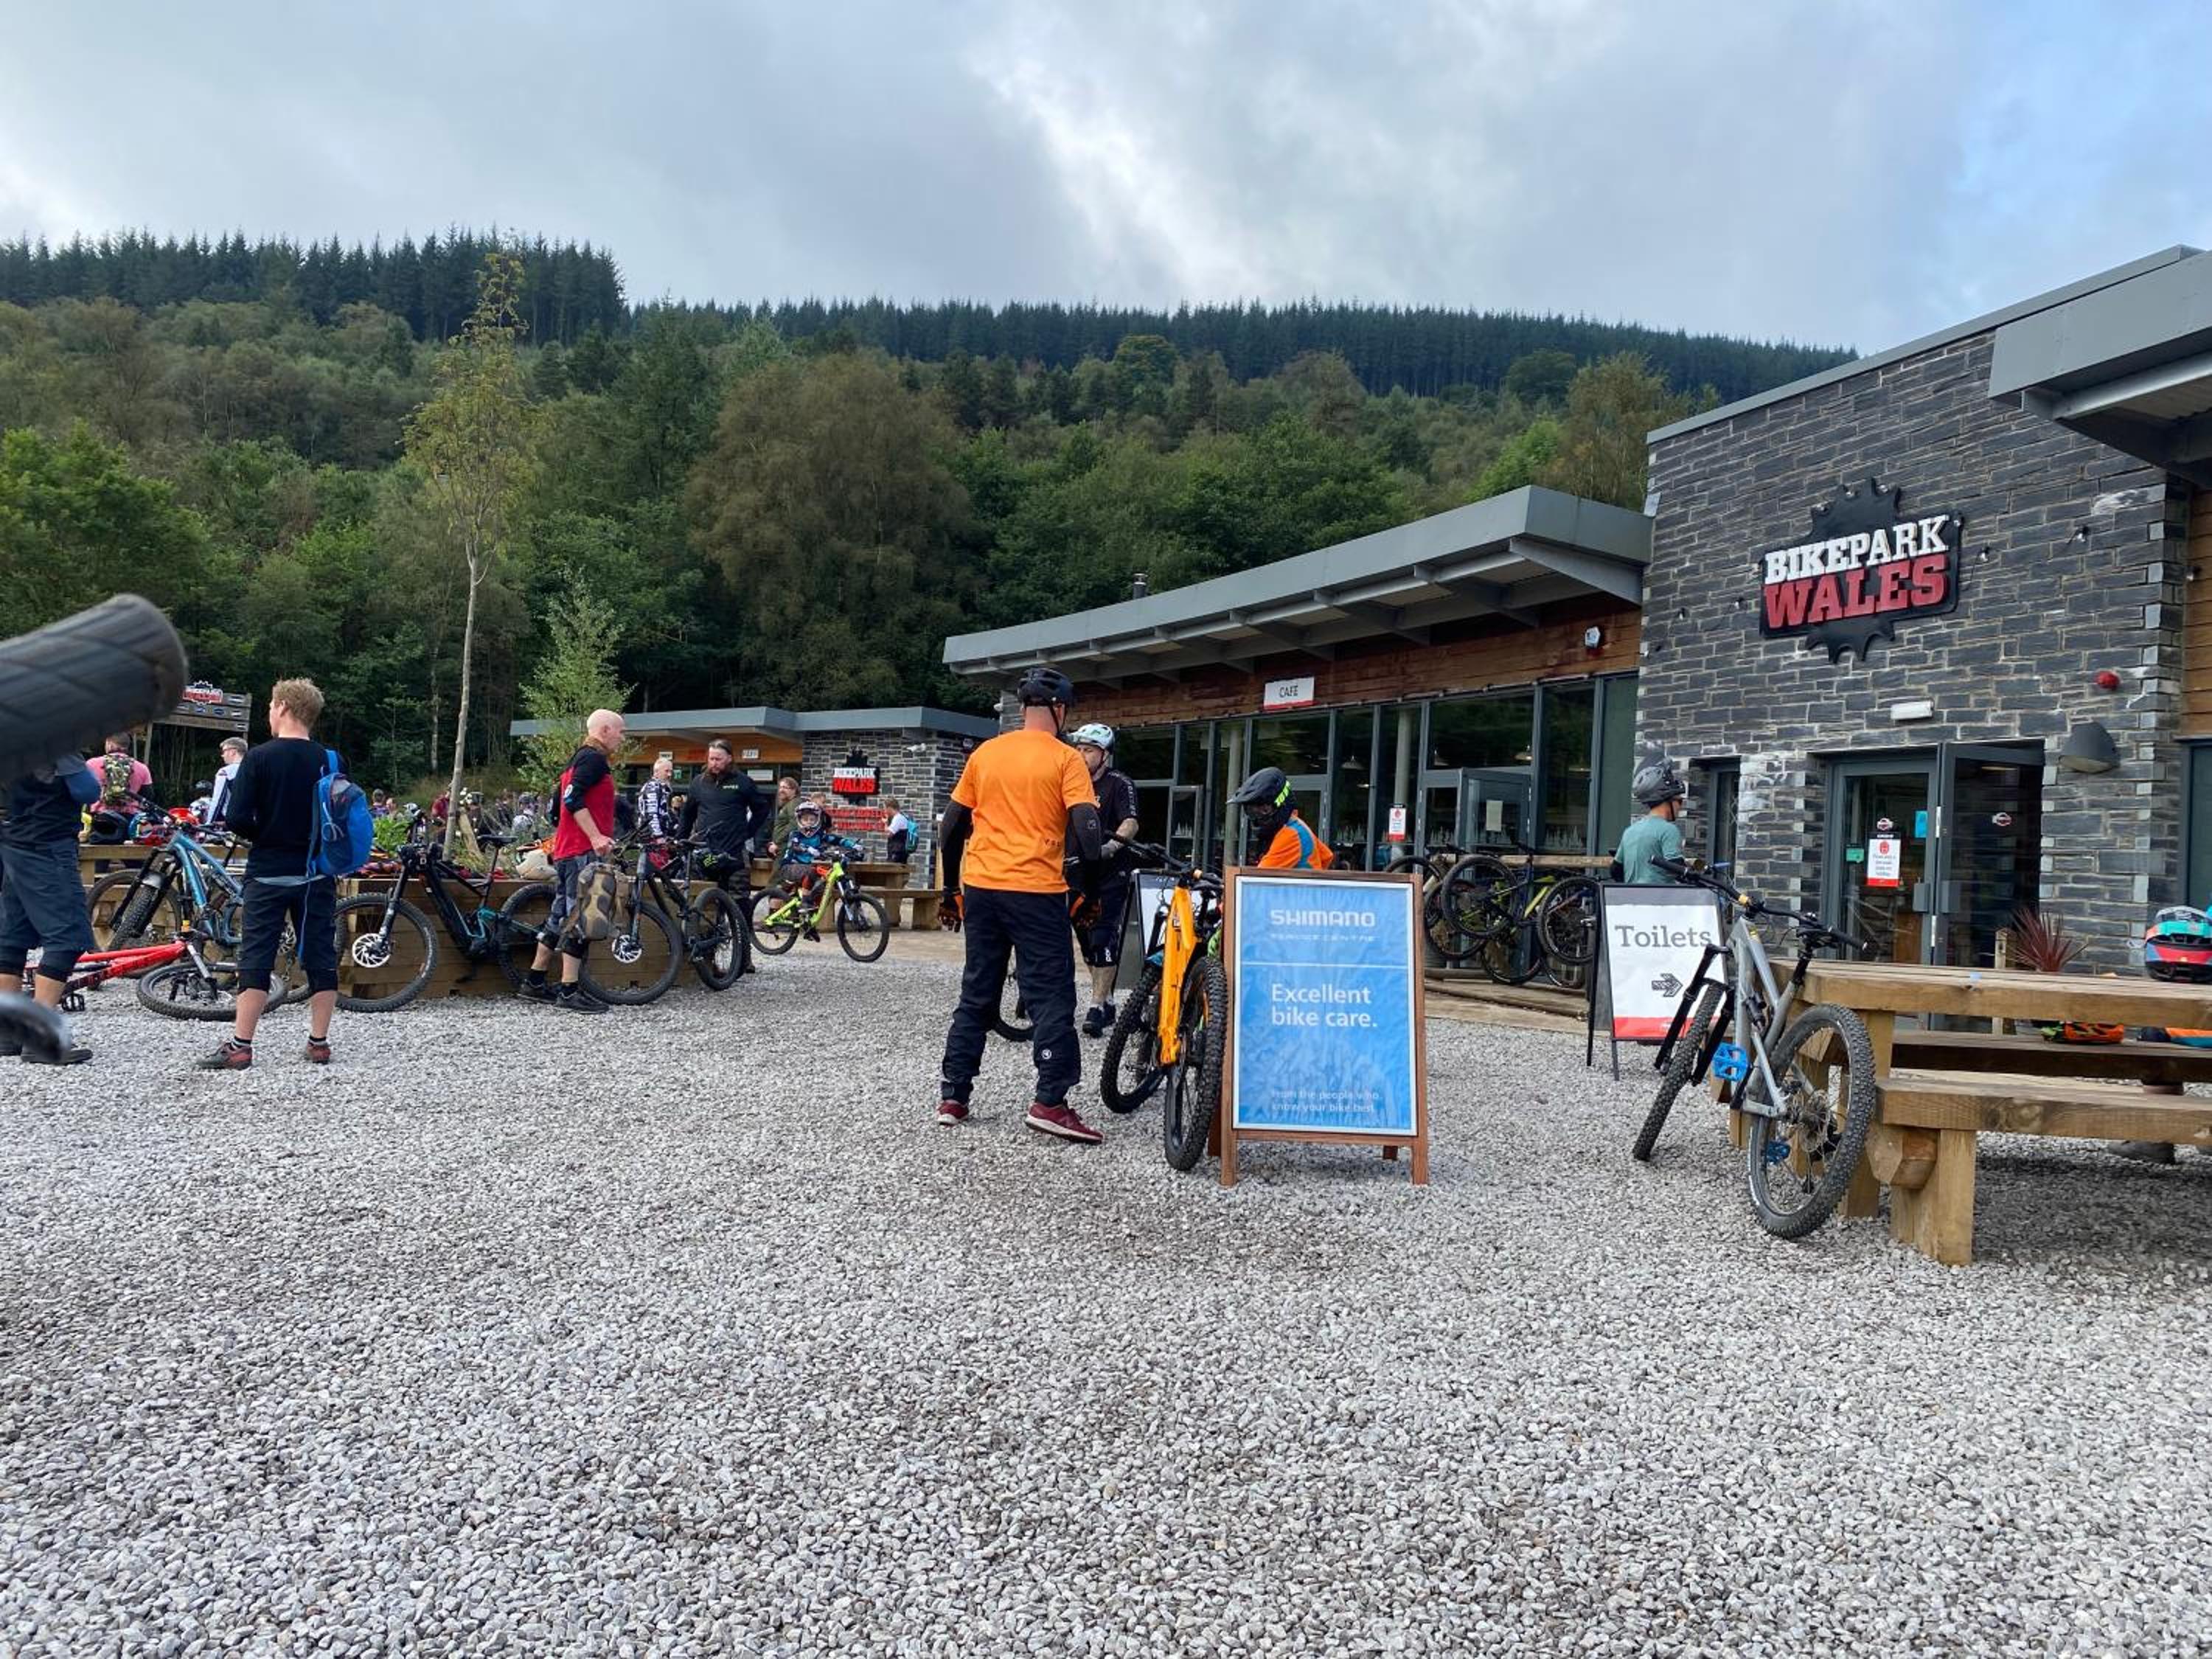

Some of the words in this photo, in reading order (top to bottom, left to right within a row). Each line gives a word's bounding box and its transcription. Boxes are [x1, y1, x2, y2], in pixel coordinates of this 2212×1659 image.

[1764, 515, 1950, 585] BIKEPARK
[1763, 554, 1947, 629] WALES
[833, 778, 874, 793] WALES
[1270, 908, 1376, 928] SHIMANO
[1614, 925, 1712, 947] Toilets
[1272, 983, 1371, 1004] Excellent
[1272, 1006, 1319, 1026] bike
[1325, 1011, 1378, 1027] care.
